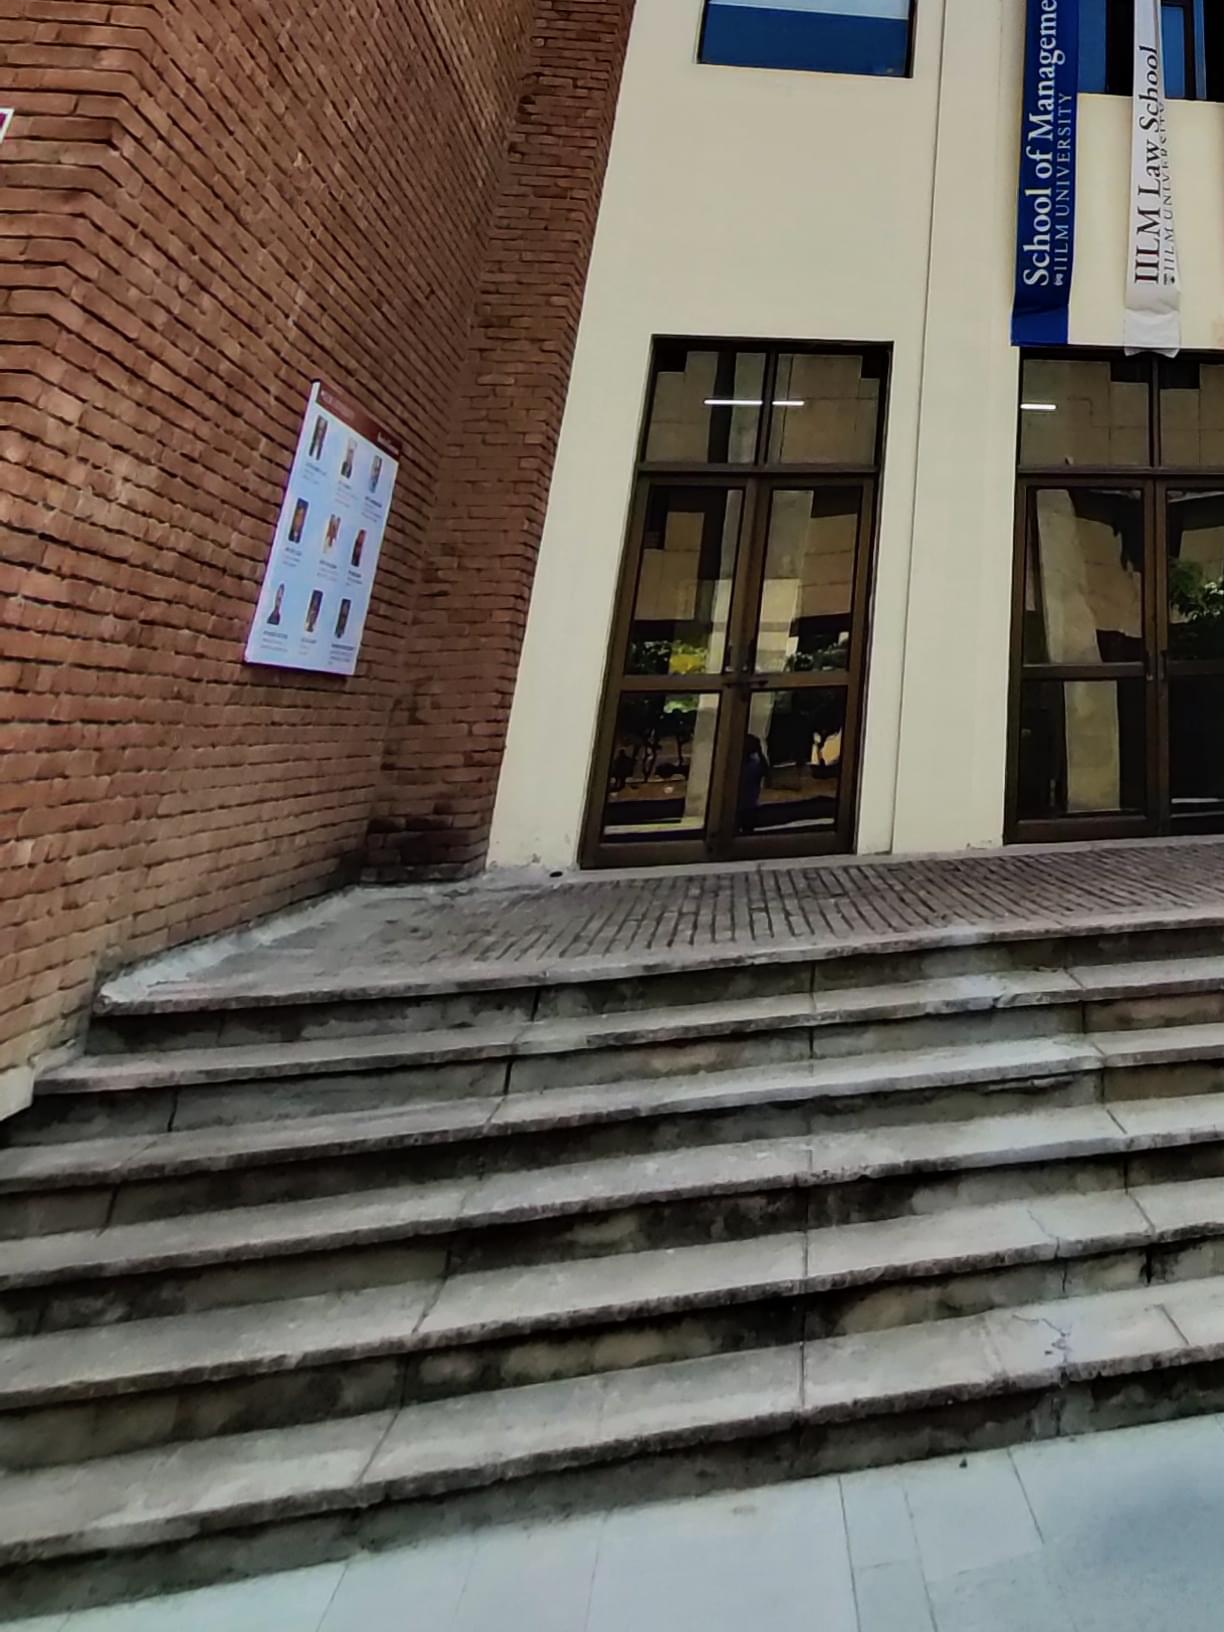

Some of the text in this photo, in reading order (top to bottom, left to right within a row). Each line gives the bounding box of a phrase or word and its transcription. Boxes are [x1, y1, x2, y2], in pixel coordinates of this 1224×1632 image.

[1025, 145, 1053, 179] of
[1054, 93, 1073, 271] IILM UNIVERSITY
[1134, 45, 1161, 284] IILM Law School
[1022, 187, 1053, 286] School
